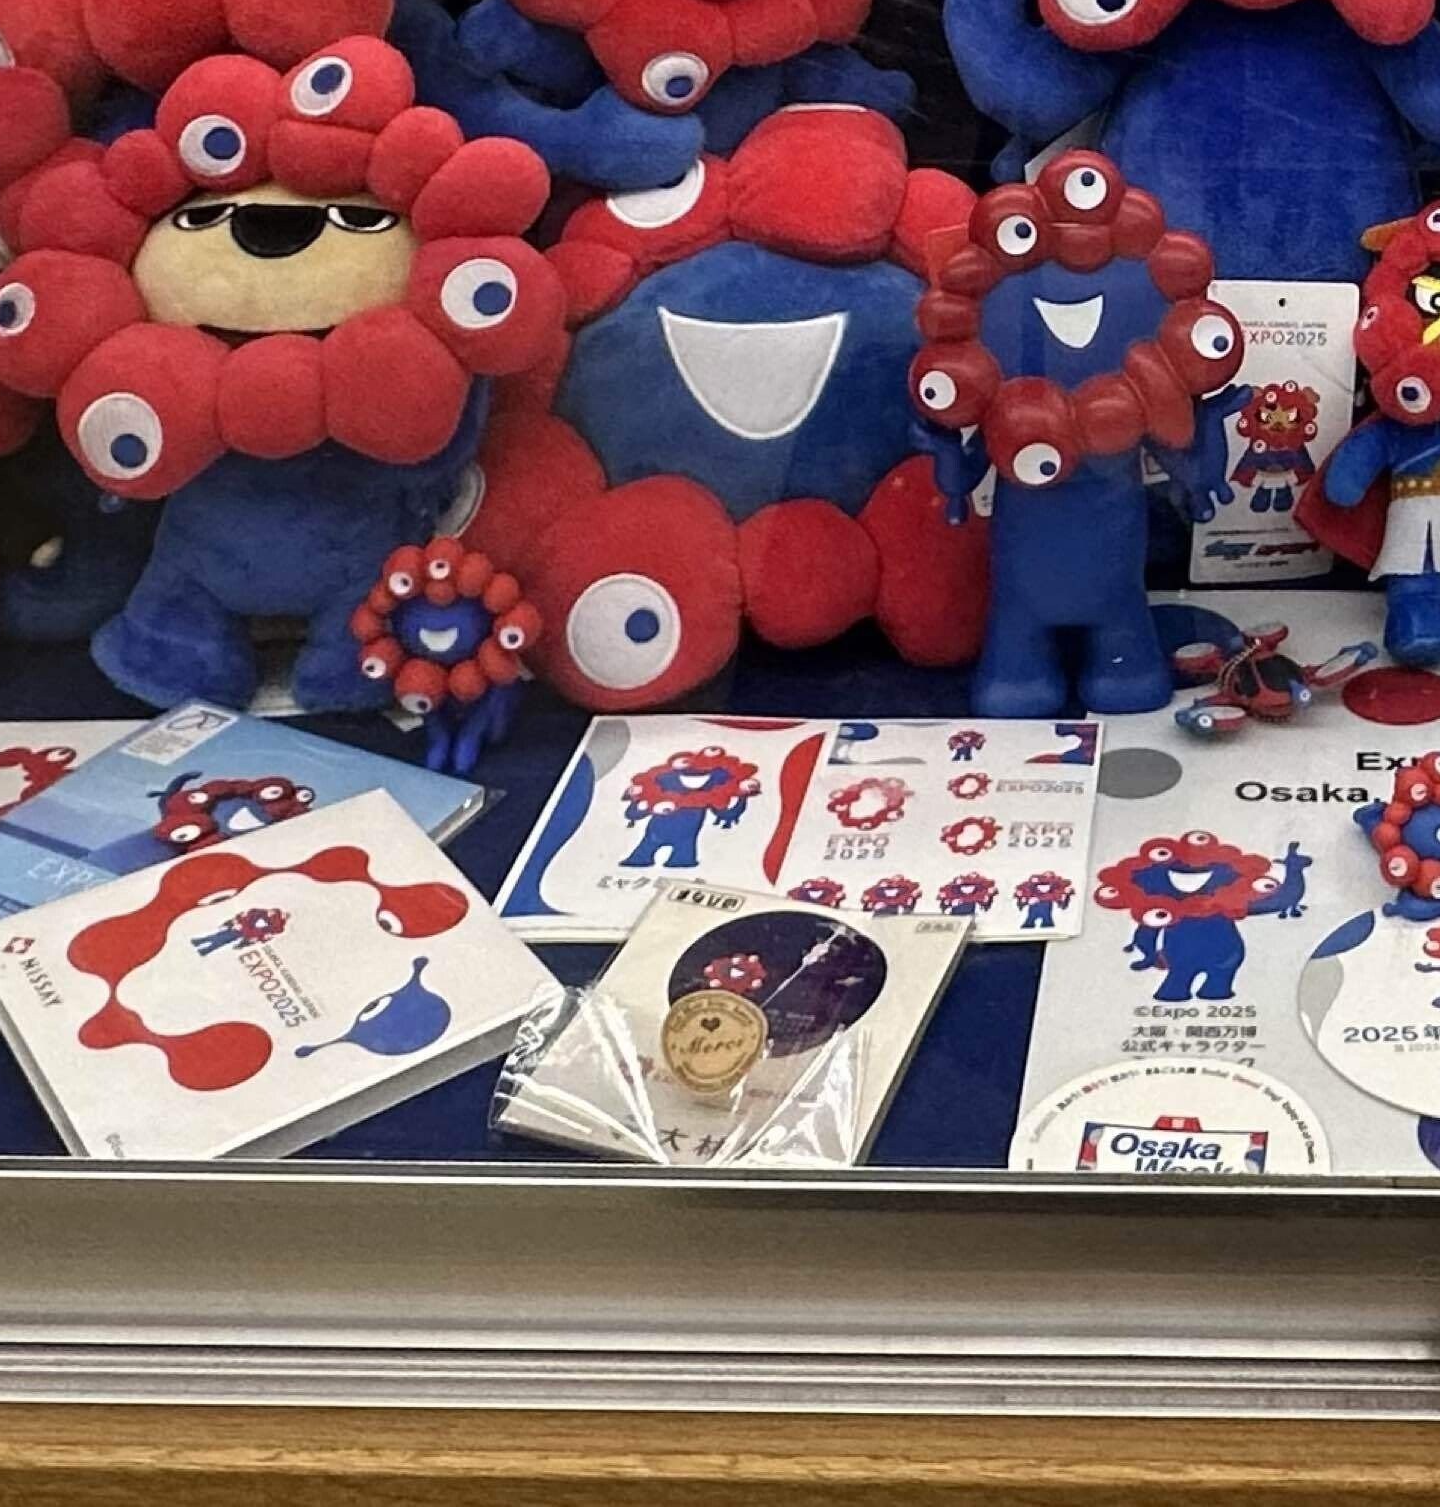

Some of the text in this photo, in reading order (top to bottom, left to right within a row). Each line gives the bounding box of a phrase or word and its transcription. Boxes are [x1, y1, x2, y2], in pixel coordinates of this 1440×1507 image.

[1242, 330, 1328, 347] XPO2025
[1234, 780, 1383, 806] Osaka,
[1008, 821, 1075, 837] EXPO
[827, 833, 890, 849] EXPO
[1007, 834, 1073, 849] 2025
[822, 846, 886, 861] 2025
[21, 955, 63, 1009] NISSAY
[237, 951, 308, 1029] EXPO2025
[1206, 1005, 1257, 1019] 2025
[1132, 1025, 1258, 1039] 大阪・関西万博
[1109, 1131, 1223, 1161] Osaka
